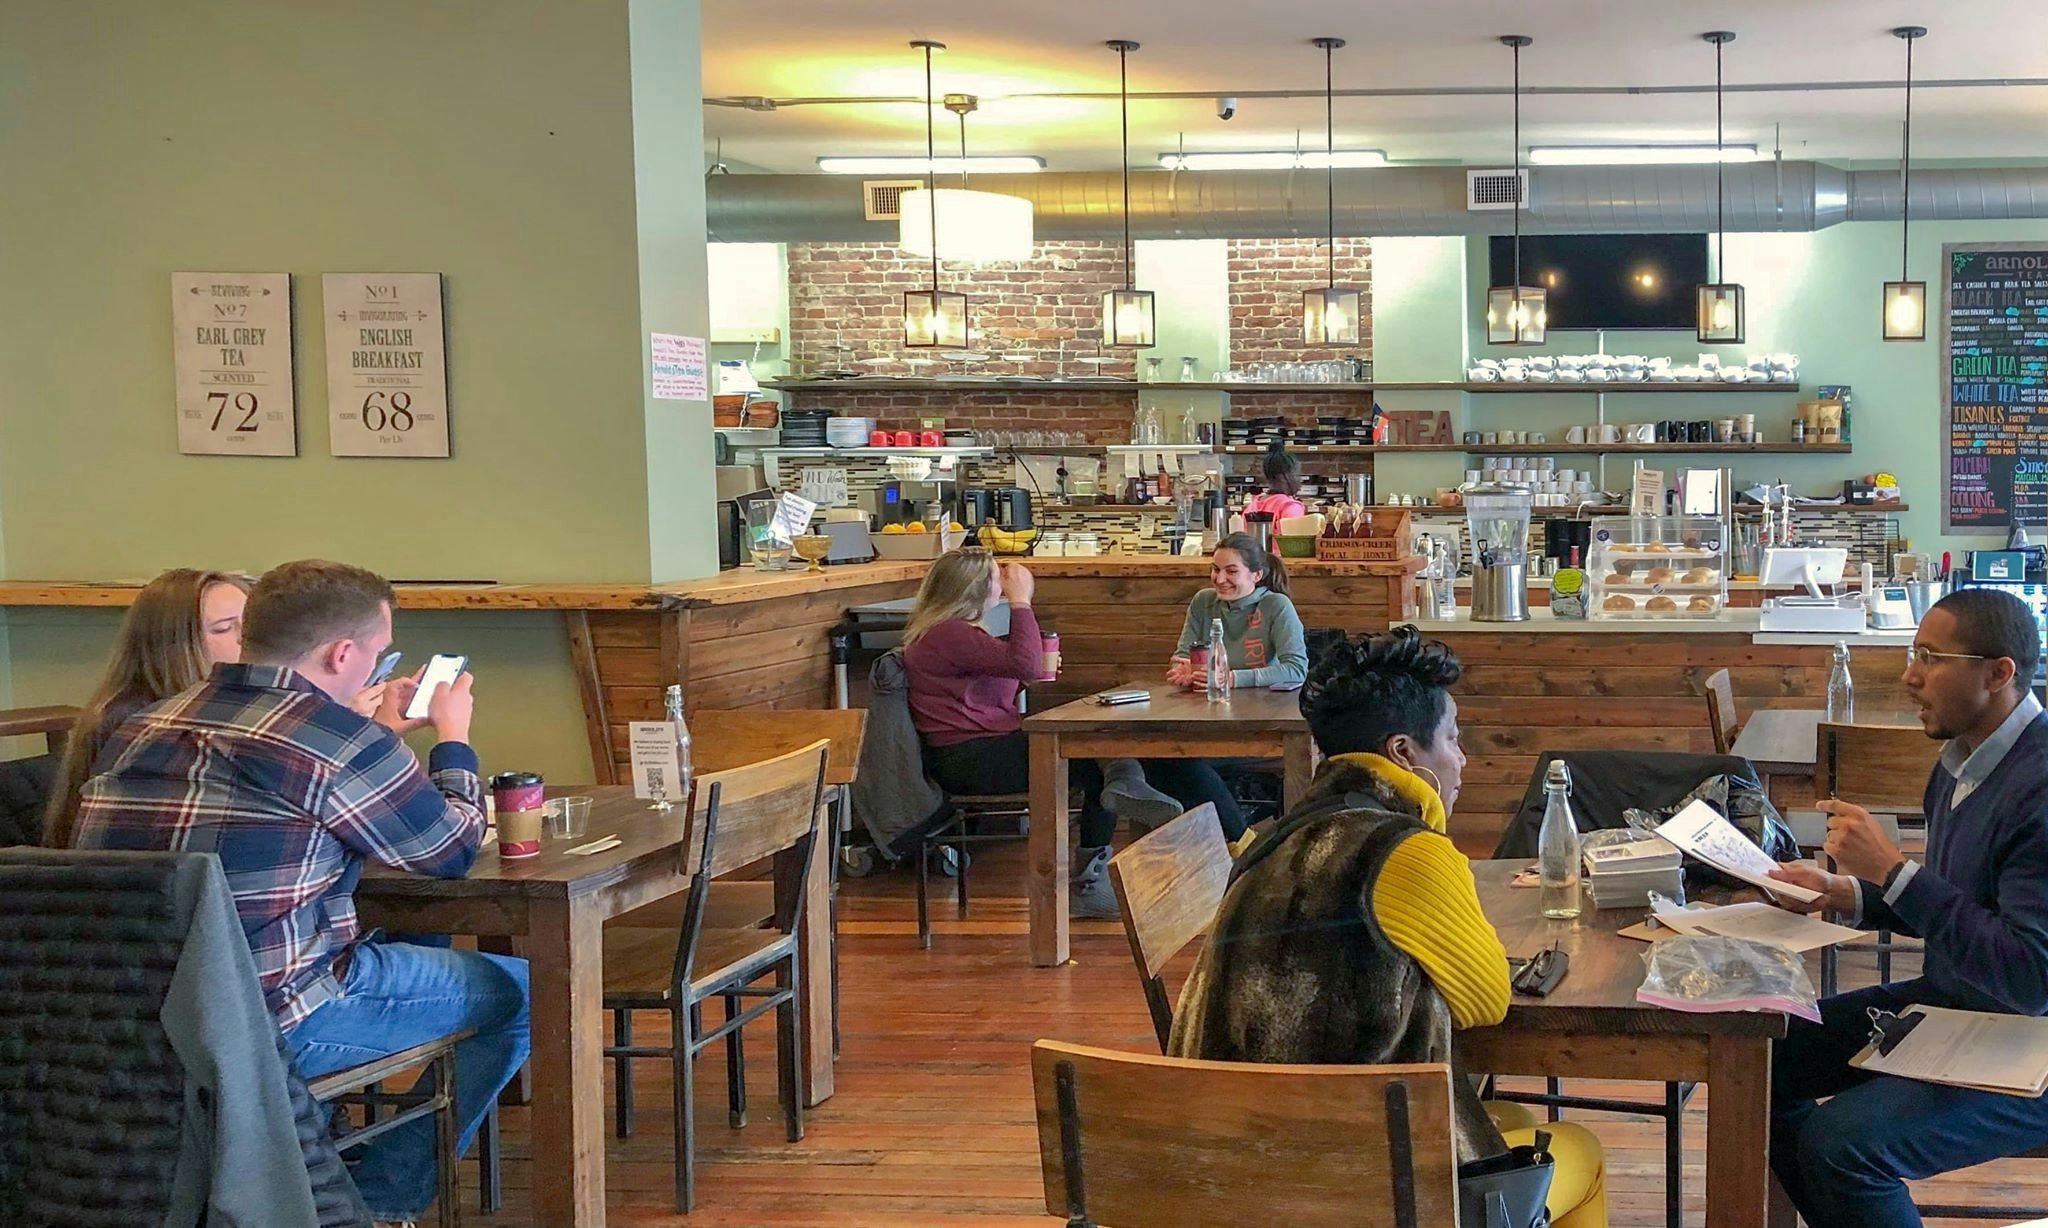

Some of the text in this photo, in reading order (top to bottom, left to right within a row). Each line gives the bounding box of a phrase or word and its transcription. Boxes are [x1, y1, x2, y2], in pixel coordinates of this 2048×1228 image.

[239, 304, 247, 317] 7
[197, 326, 267, 346] EARL GREY
[359, 328, 414, 347] ENGLISH
[220, 348, 246, 367] TEA
[351, 350, 424, 369] BREAKFAST
[1952, 355, 2017, 375] GREEN TEA
[1952, 384, 2018, 402] WHITE TEA
[207, 391, 260, 432] 72
[362, 390, 414, 432] 68
[1953, 405, 2004, 423] TISANES
[1389, 411, 1455, 445] TEA
[1319, 551, 1393, 560] LOCAL HONEY
